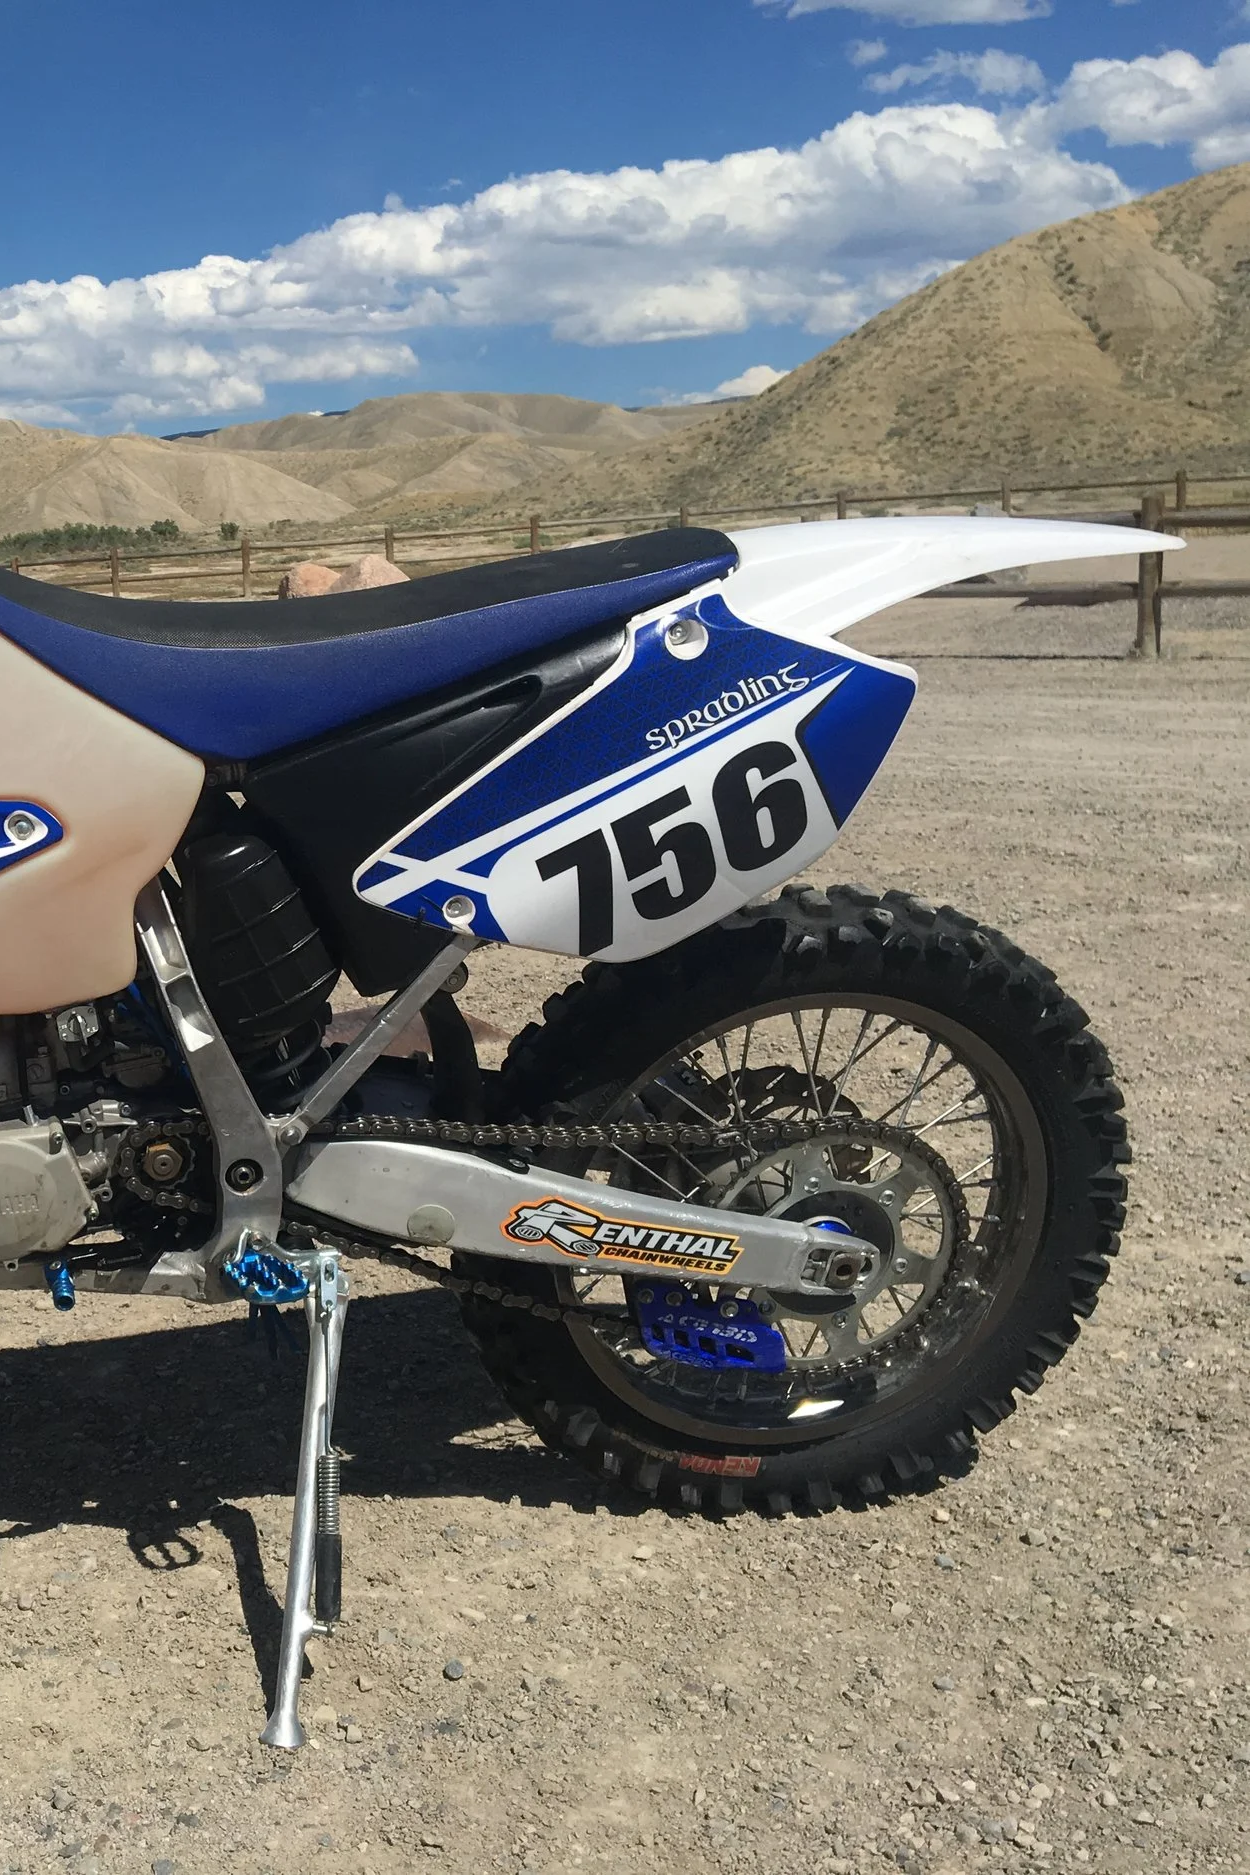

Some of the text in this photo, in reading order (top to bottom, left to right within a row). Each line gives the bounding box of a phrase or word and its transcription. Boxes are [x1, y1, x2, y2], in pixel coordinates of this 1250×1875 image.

[535, 740, 808, 957] 756
[508, 1201, 736, 1259] RENTHAL
[603, 1246, 727, 1272] CHAINWHEELS
